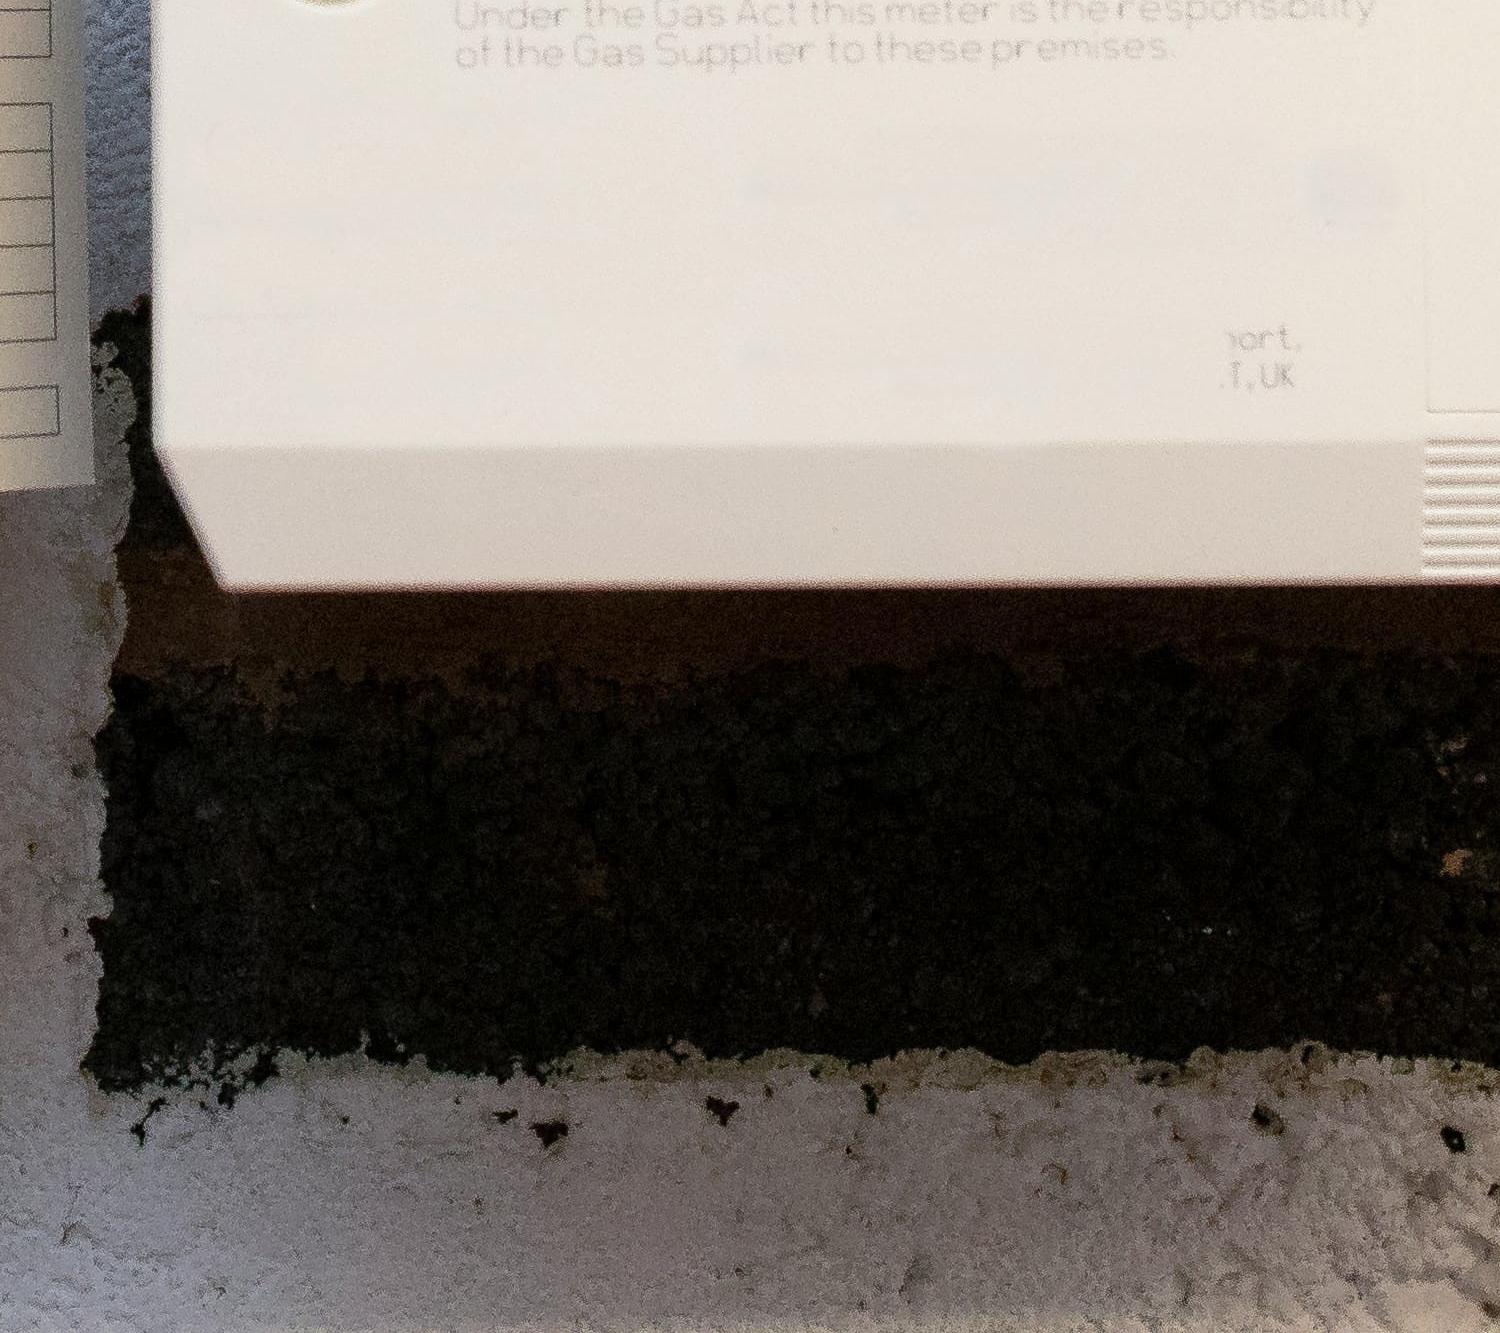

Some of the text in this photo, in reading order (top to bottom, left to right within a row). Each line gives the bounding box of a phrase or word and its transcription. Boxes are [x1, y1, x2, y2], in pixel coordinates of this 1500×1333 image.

[456, 32, 1177, 73] of the Gas Supplier to these premises.
